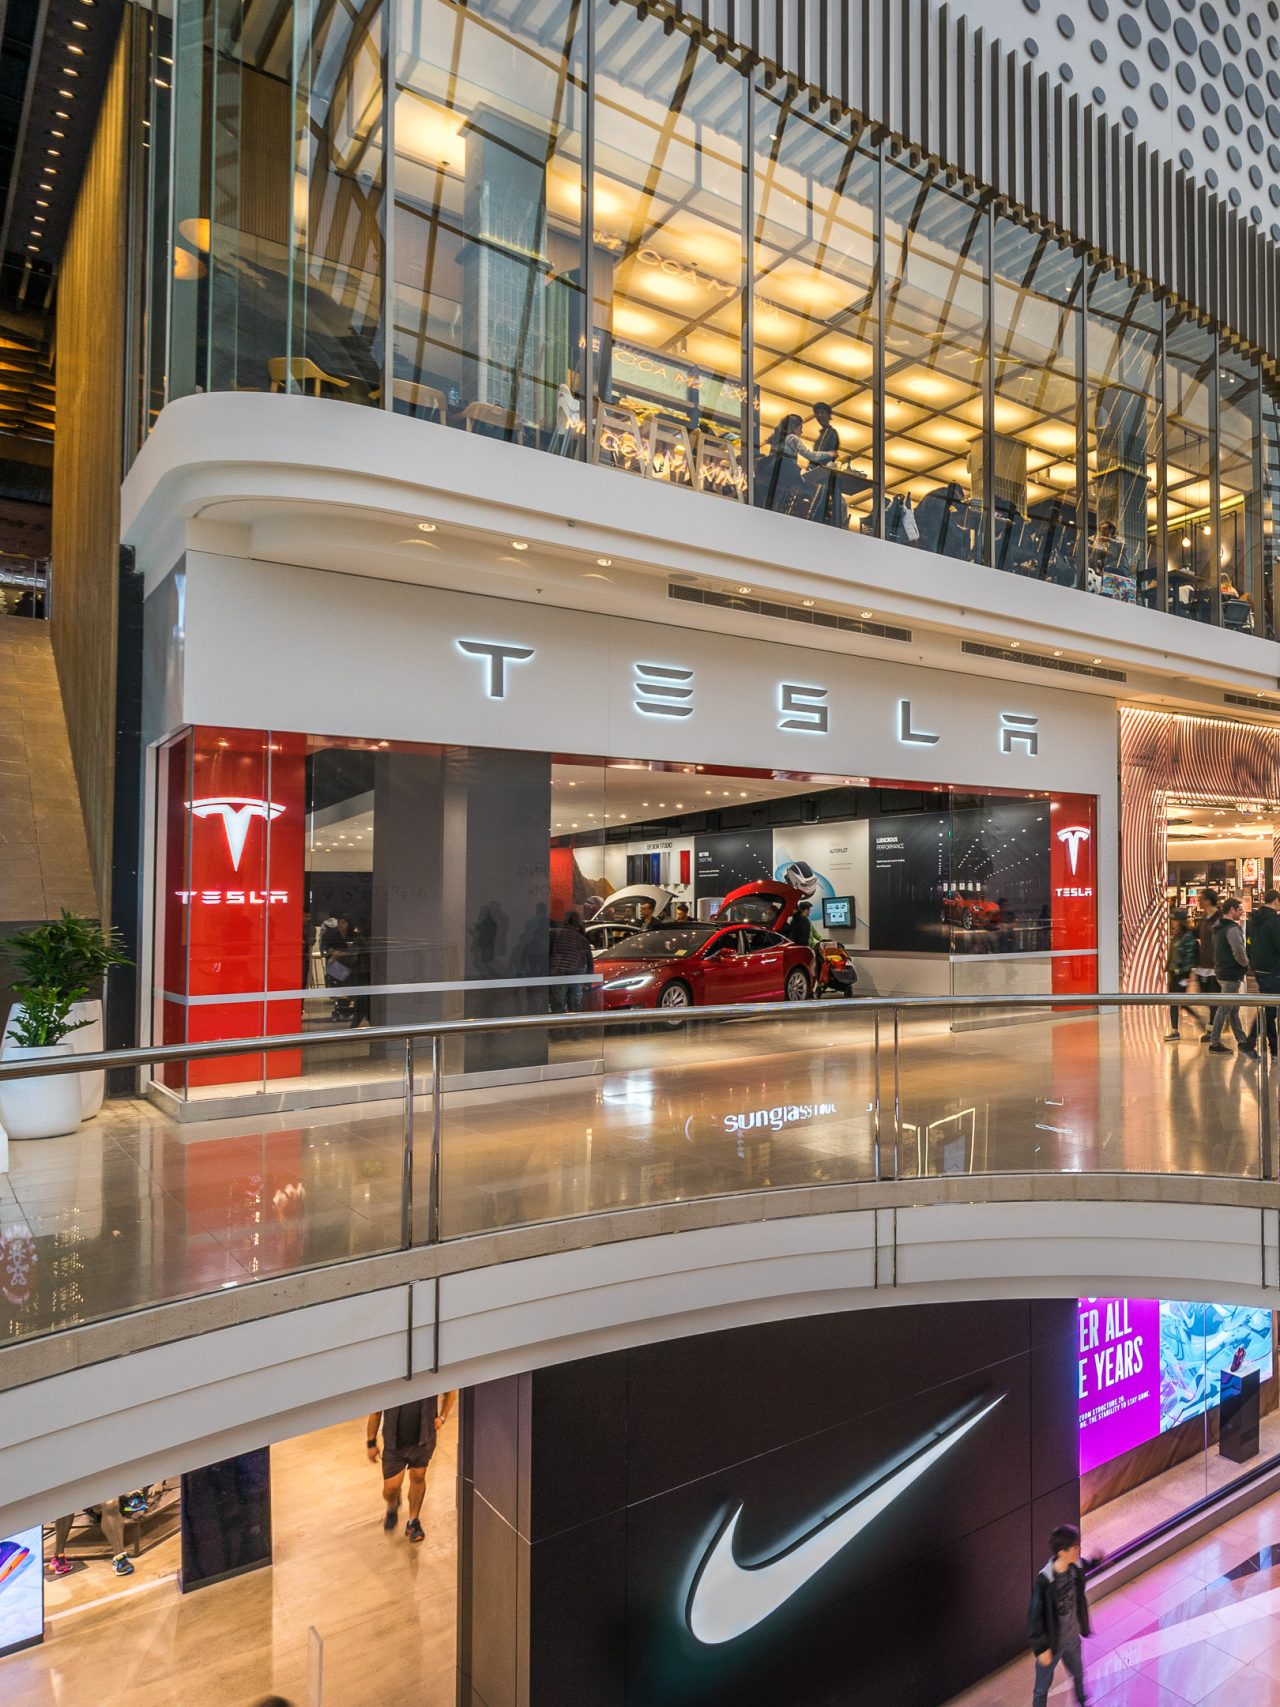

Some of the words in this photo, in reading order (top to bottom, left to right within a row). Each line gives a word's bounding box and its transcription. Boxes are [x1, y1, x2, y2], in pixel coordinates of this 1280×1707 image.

[458, 639, 1039, 757] TESLA
[175, 891, 288, 904] TESLA
[1055, 887, 1092, 897] TESLA
[1105, 1298, 1132, 1343] ALL
[1094, 1335, 1143, 1391] YEARS
[1089, 1415, 1097, 1425] THE
[1098, 1404, 1120, 1421] STABILITY
[1127, 1396, 1138, 1407] STAY
[1092, 1398, 1118, 1416] STRUCTURE
